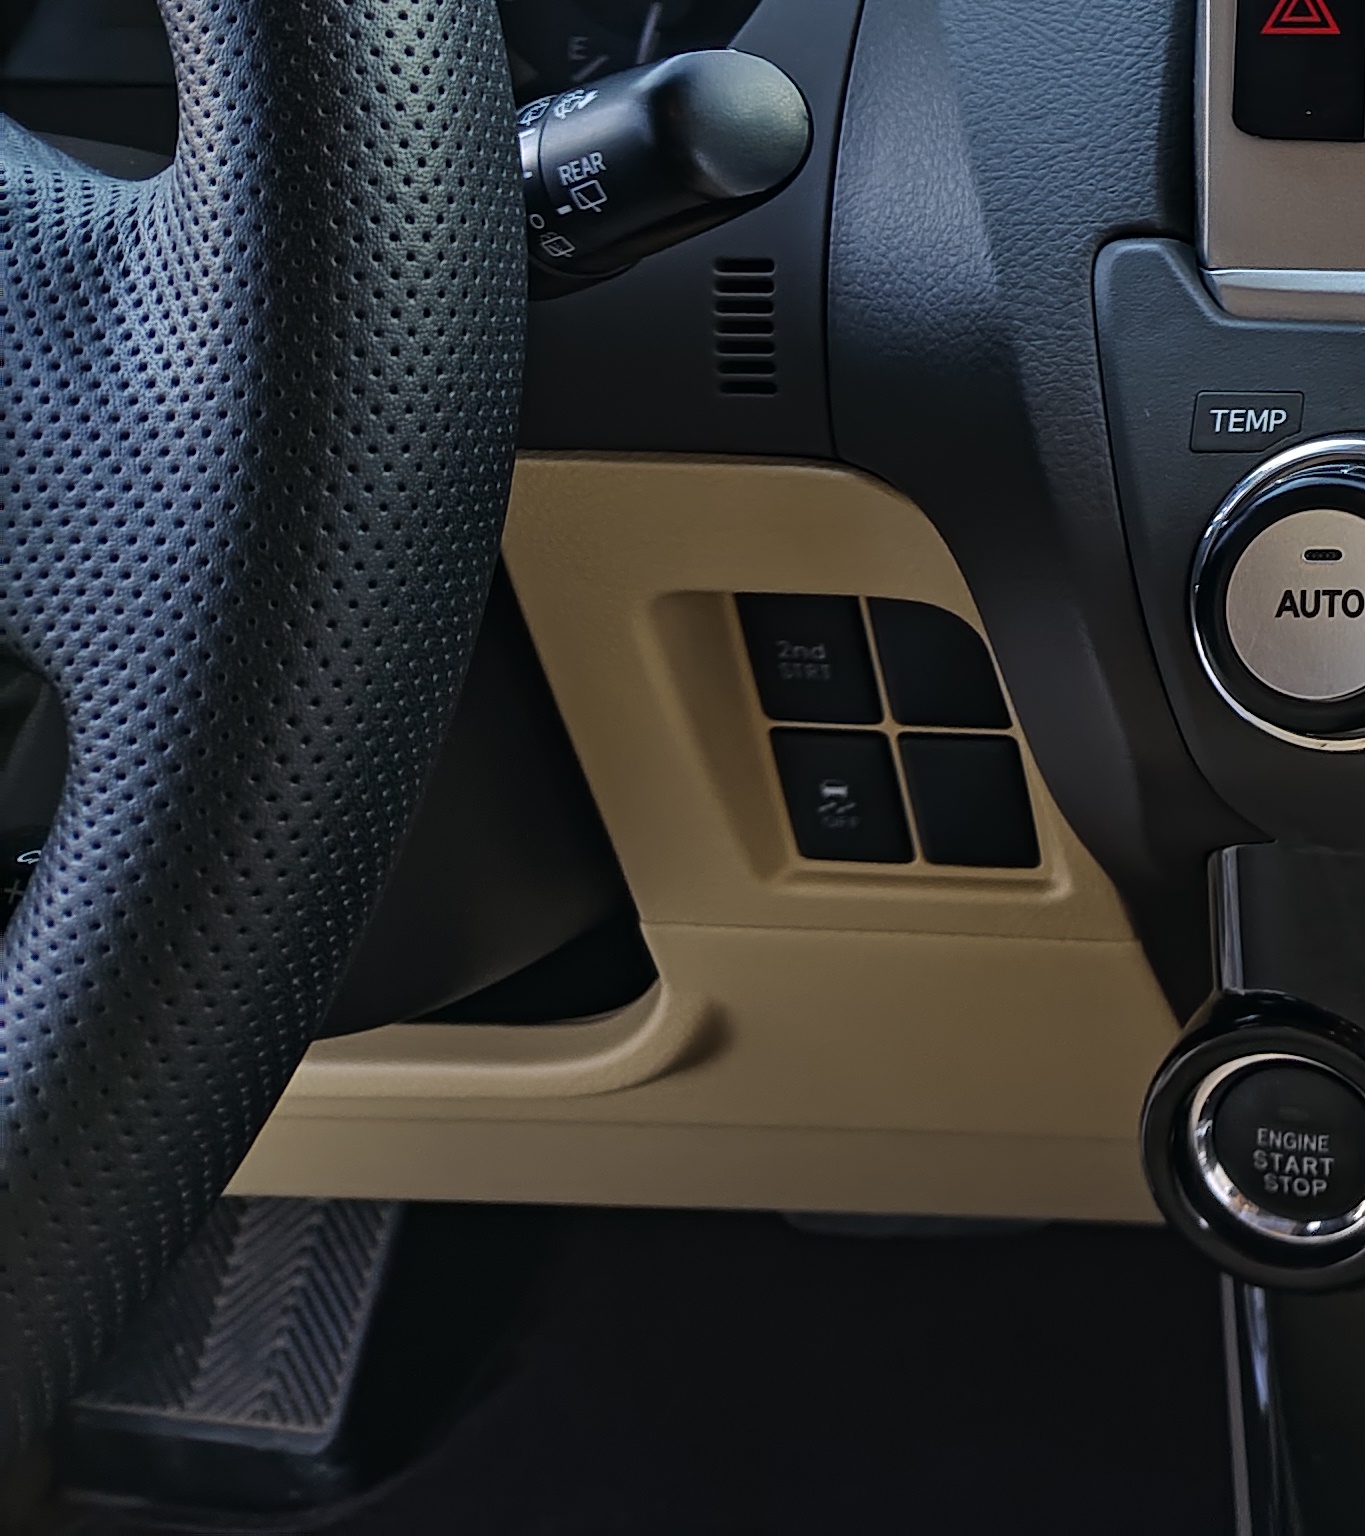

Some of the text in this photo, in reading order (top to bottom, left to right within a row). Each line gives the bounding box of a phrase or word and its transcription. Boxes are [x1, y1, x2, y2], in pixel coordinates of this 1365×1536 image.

[557, 152, 607, 186] REAR
[1209, 409, 1288, 433] TEMP
[1274, 589, 1365, 619] AUTO
[775, 639, 826, 661] 2nd
[1256, 1128, 1330, 1154] ENGINE
[1252, 1150, 1335, 1177] START
[1263, 1173, 1328, 1197] STOP
